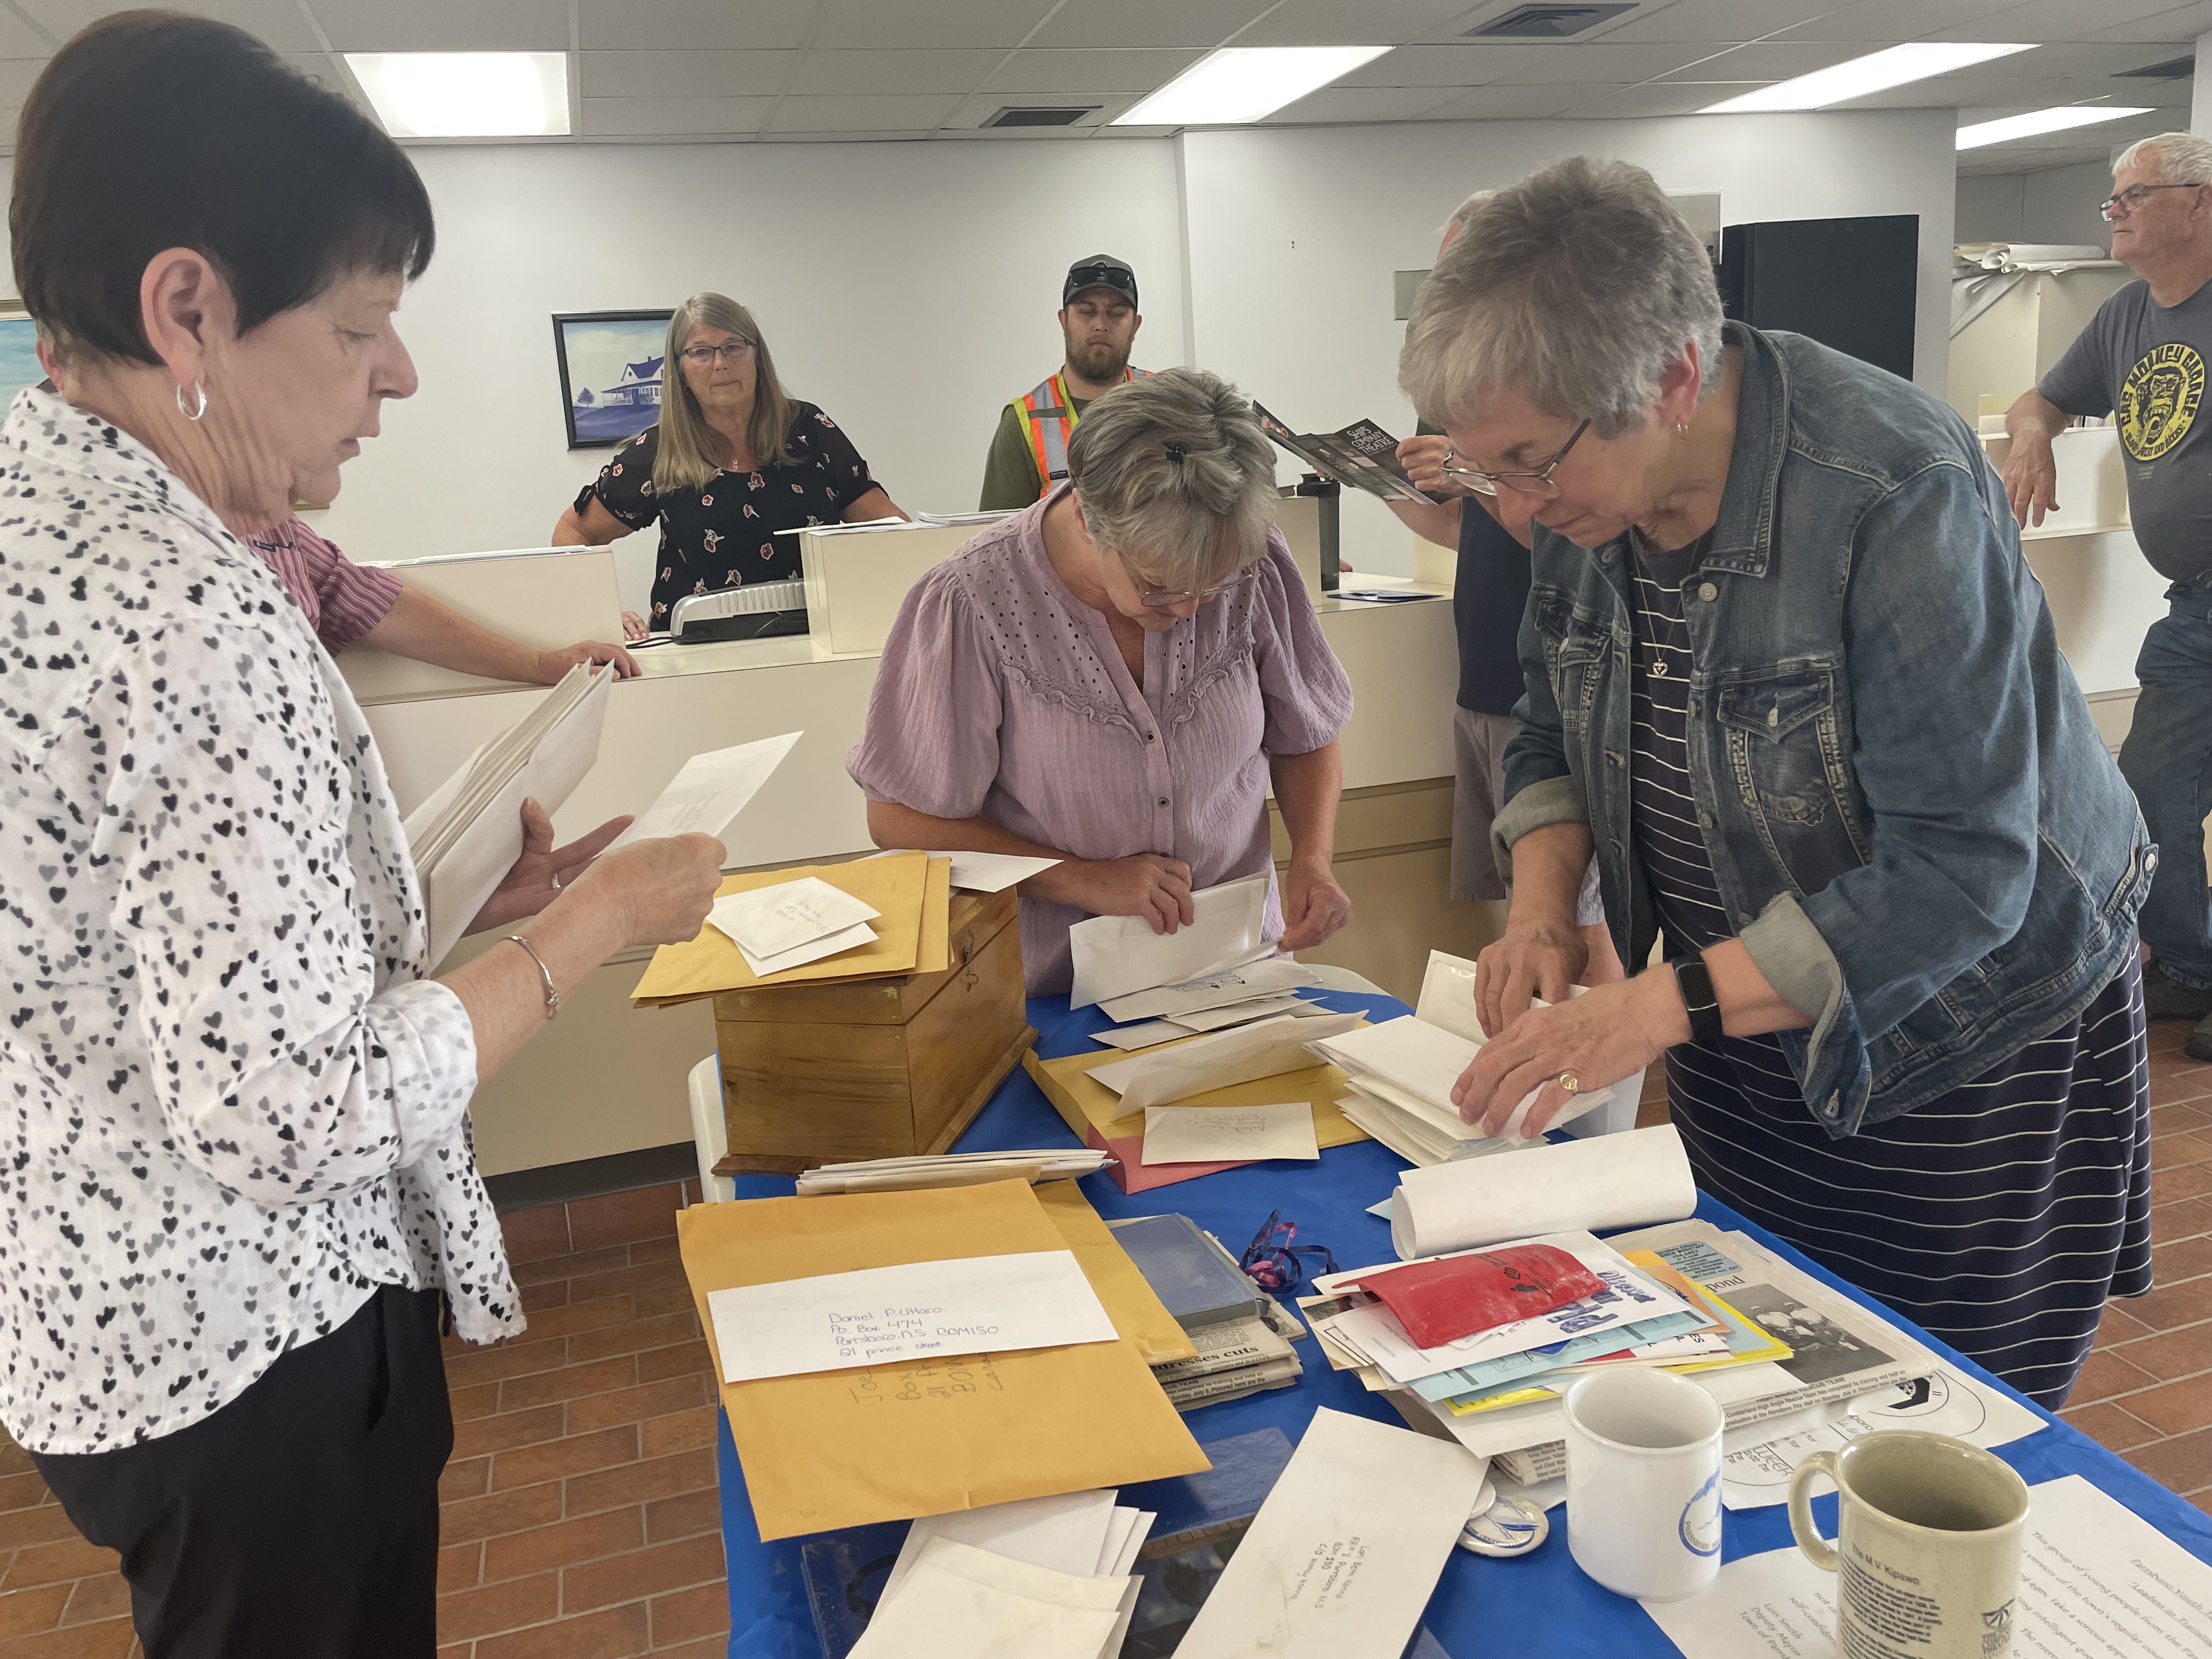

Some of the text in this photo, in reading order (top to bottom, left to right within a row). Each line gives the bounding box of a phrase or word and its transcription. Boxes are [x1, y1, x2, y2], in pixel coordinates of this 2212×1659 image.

[2128, 345, 2185, 389] MONKEY
[1352, 430, 1384, 447] COMPANY
[1358, 436, 1393, 453] THEATRE
[829, 1312, 873, 1323] Daniel
[887, 1318, 923, 1328] 474
[840, 1347, 856, 1357] 21
[866, 1345, 904, 1358] prince
[1223, 1346, 1259, 1358] cuts
[1180, 1379, 1199, 1387] TEAM
[1213, 1377, 1233, 1386] training
[1827, 1376, 1846, 1386] TEAM
[1193, 1388, 1204, 1397] July
[1211, 1384, 1233, 1392] Pictured
[1725, 1406, 1757, 1418] Cumberland
[1757, 1403, 1769, 1411] High
[1770, 1400, 1785, 1409] Angle
[1785, 1396, 1803, 1405] Rescue
[1725, 1415, 1752, 1426] graduation
[1759, 1410, 1767, 1419] the
[1793, 1402, 1803, 1410] Fire
[1544, 1460, 1556, 1469] Chief
[2032, 1531, 2048, 1545] This
[2045, 1545, 2073, 1564] group
[1852, 1542, 1864, 1559] The
[1884, 1564, 1920, 1585] Kipawo
[2072, 1564, 2089, 1572] of
[2080, 1572, 2112, 1594] young
[1814, 1593, 1831, 1605] not
[2027, 1553, 2056, 1577] version
[2067, 1584, 2083, 1597] the
[2111, 1620, 2143, 1643] regular
[2108, 1593, 2141, 1616] people
[1739, 1611, 1759, 1629] Town
[1758, 1630, 1774, 1638] of
[1764, 1603, 1803, 1639] Lois Smith
[2032, 1610, 2077, 1646] intelligent
[2051, 1598, 2070, 1613] take
[2075, 1619, 2107, 1644] serious
[2140, 1616, 2164, 1634] from
[1751, 1606, 1802, 1657] Deputy Mayor
[2019, 1627, 2036, 1642] The
[2165, 1634, 2181, 1647] the
